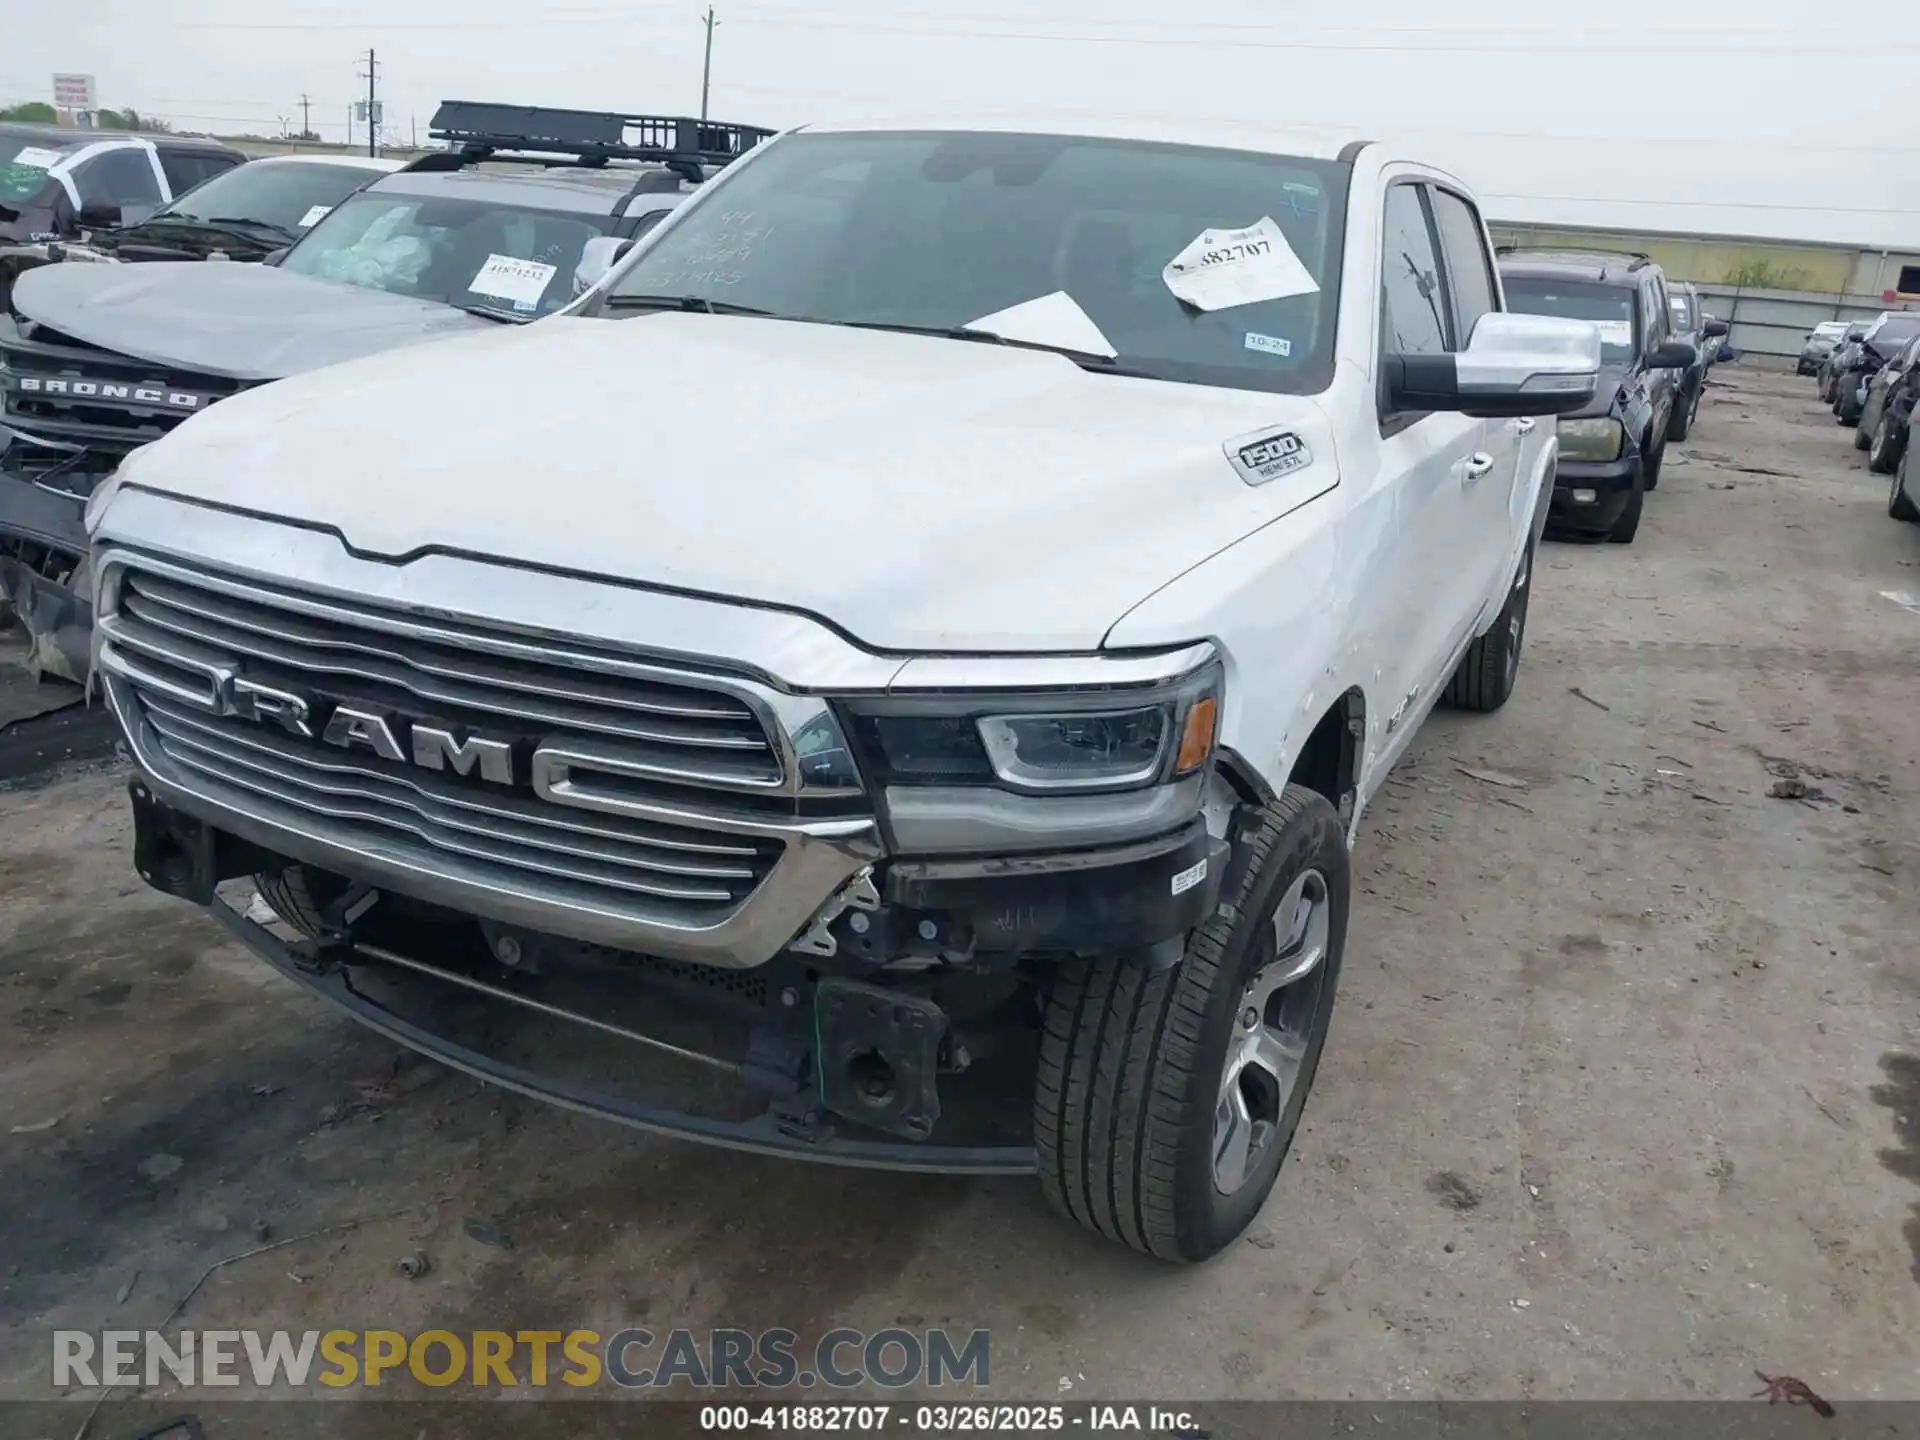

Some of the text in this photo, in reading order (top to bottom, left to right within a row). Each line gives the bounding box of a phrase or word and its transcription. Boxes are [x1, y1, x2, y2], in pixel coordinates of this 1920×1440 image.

[20, 378, 198, 407] BRONCO
[1240, 436, 1298, 467] 1500
[234, 678, 514, 785] RAM
